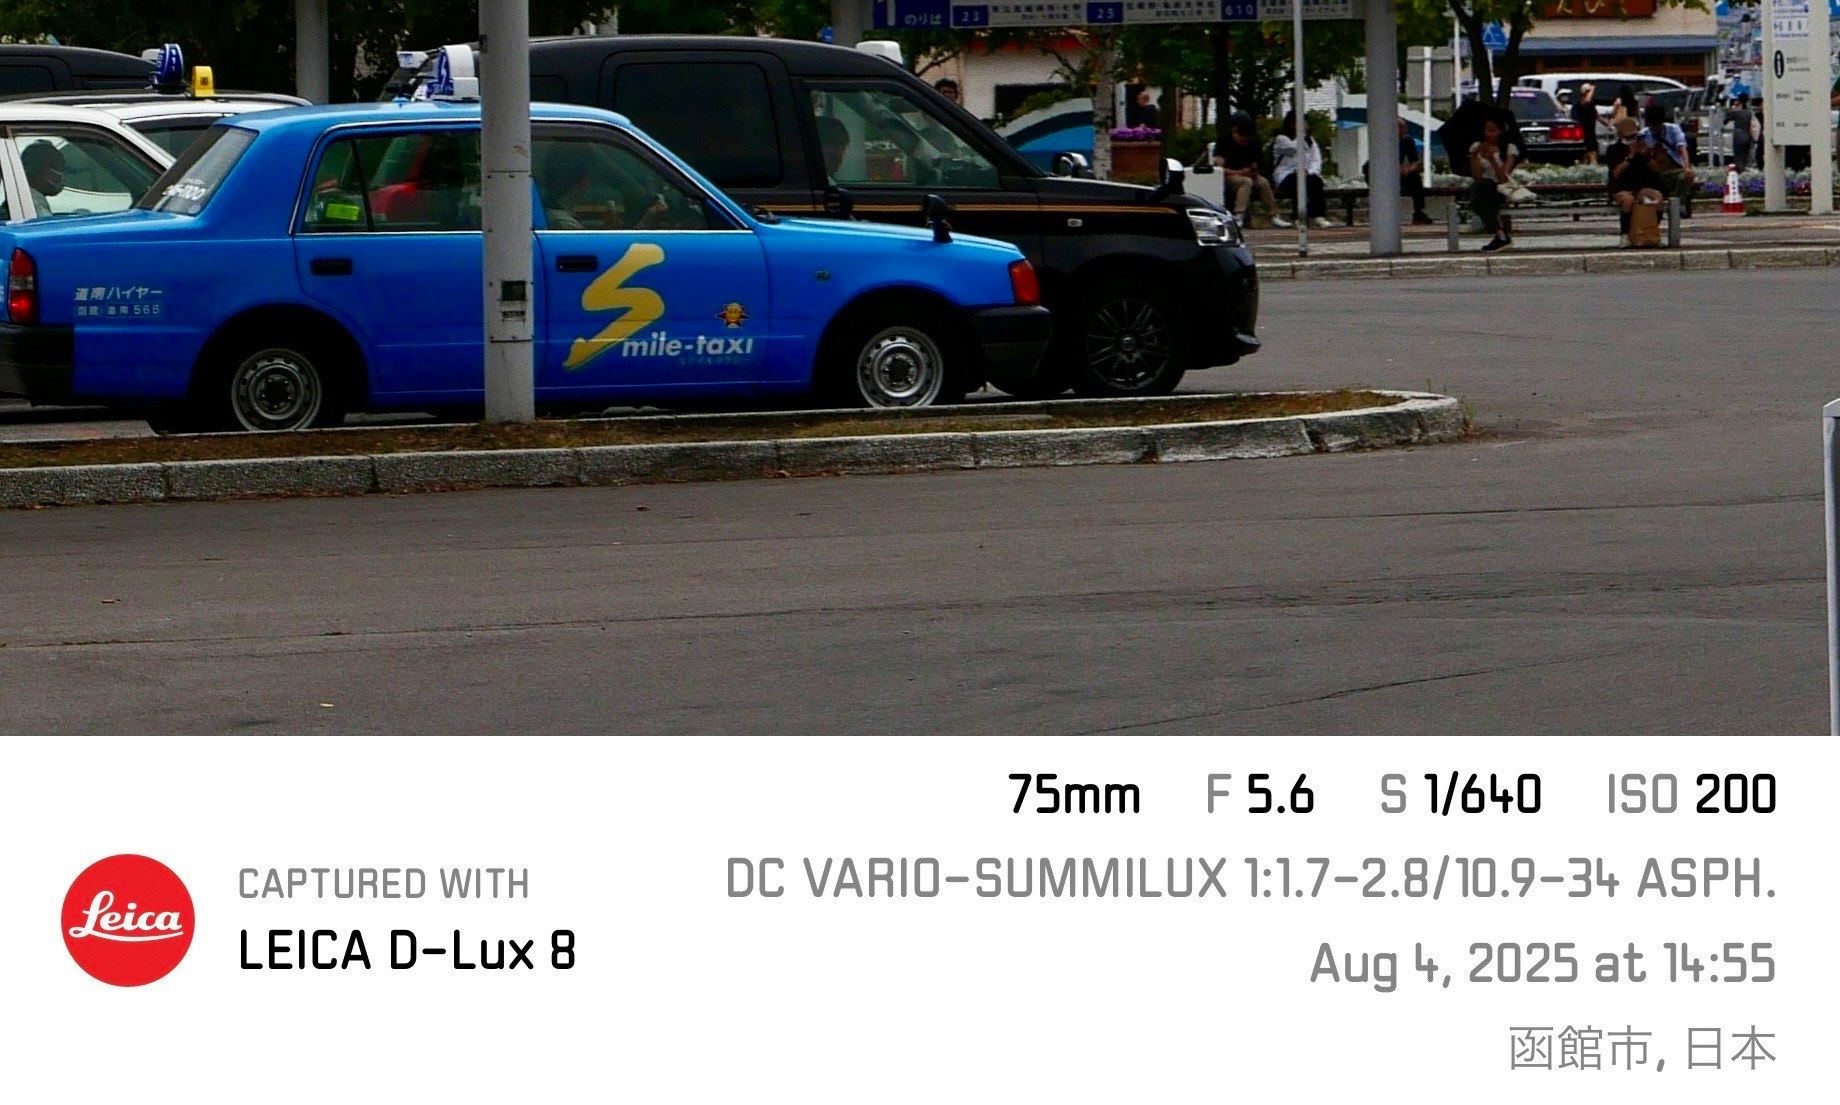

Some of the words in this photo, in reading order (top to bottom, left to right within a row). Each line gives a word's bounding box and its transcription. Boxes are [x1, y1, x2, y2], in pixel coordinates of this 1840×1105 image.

[1096, 7, 1115, 19] 25
[1224, 4, 1254, 16] 610
[961, 10, 982, 23] 23
[74, 286, 163, 301] 道南ハイヤー
